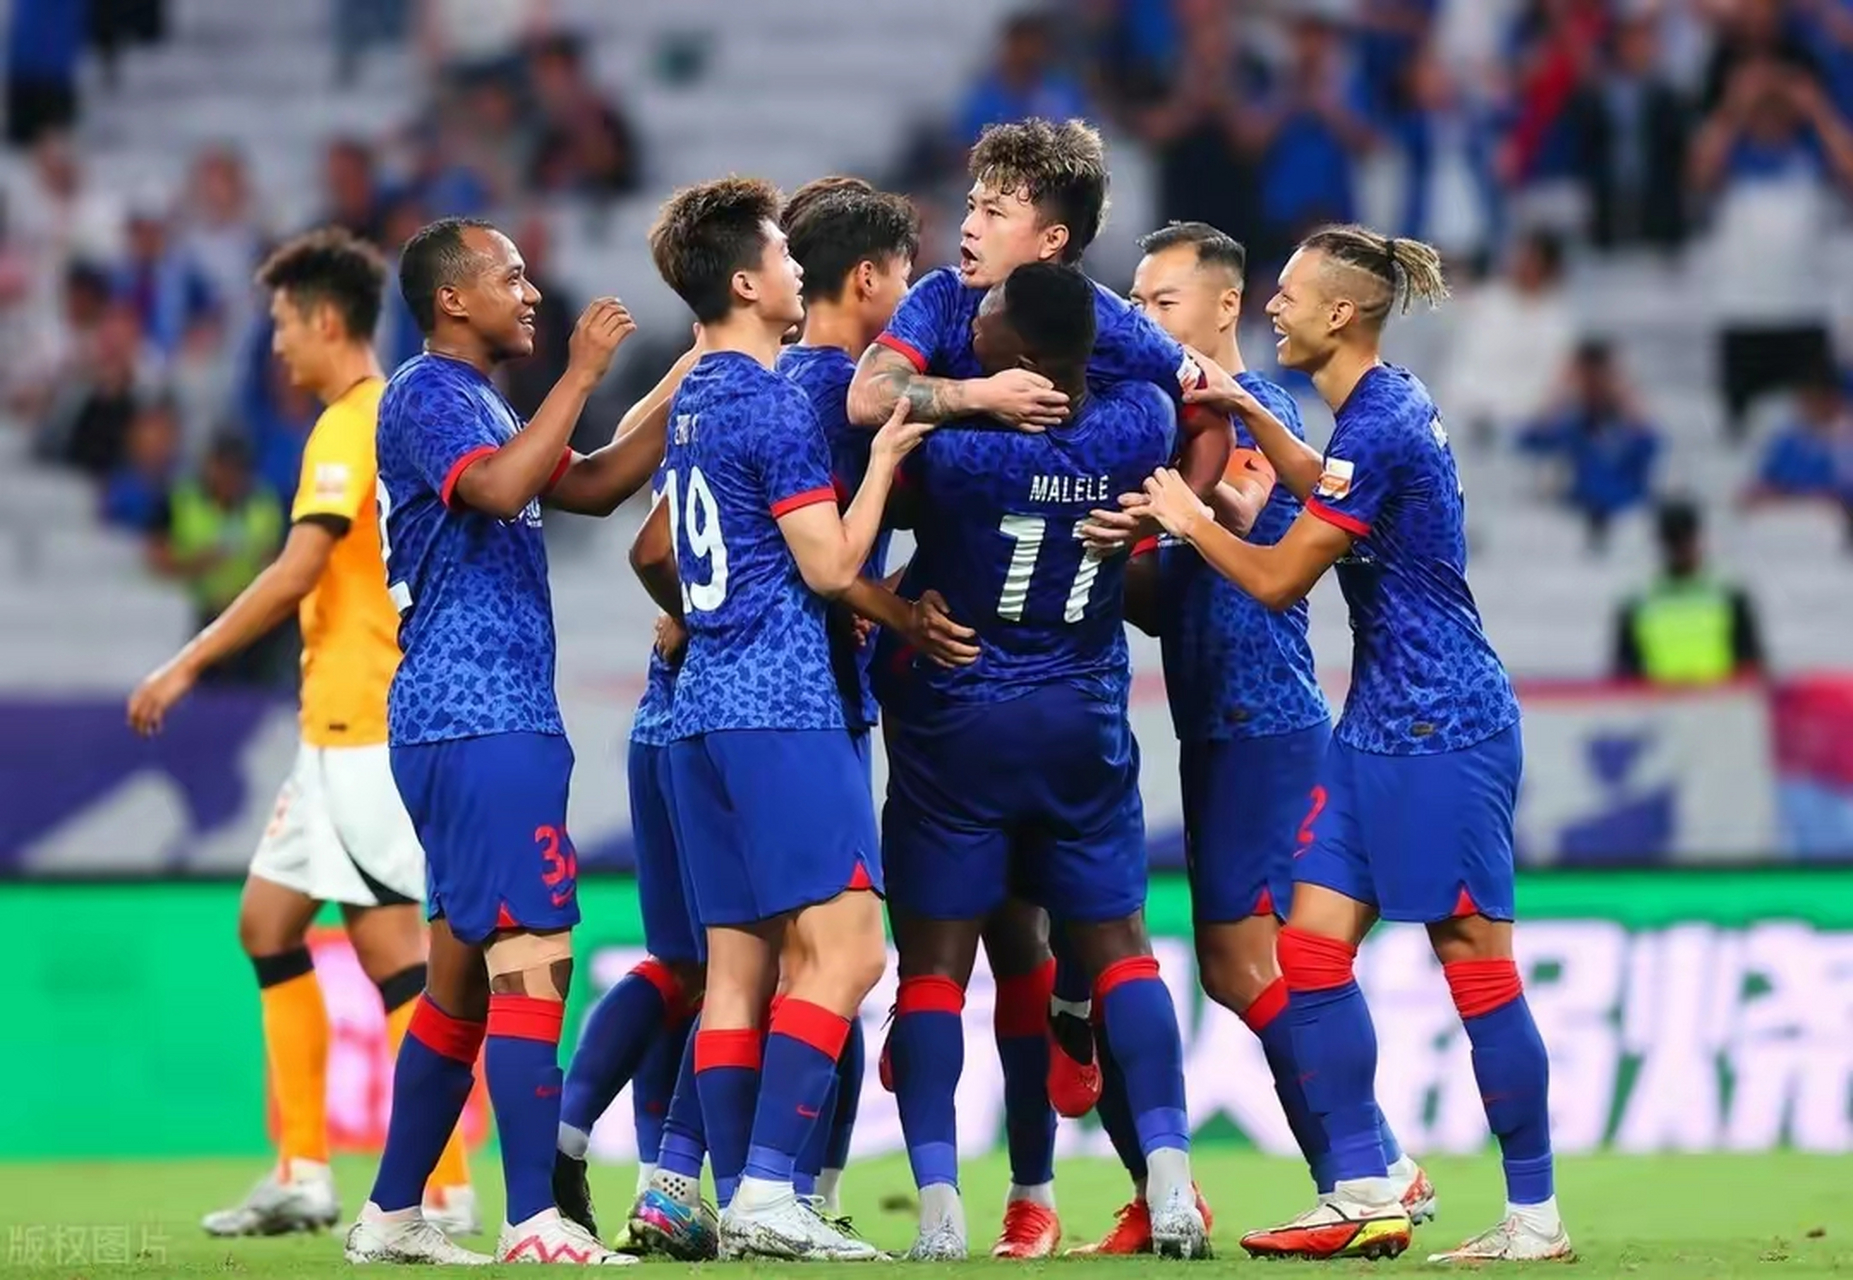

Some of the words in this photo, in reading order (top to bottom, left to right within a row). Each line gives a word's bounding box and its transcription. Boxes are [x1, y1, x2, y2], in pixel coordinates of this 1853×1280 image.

[1029, 475, 1109, 502] MALELE
[654, 465, 728, 614] 19
[997, 514, 1104, 623] 11
[1296, 784, 1327, 843] 2
